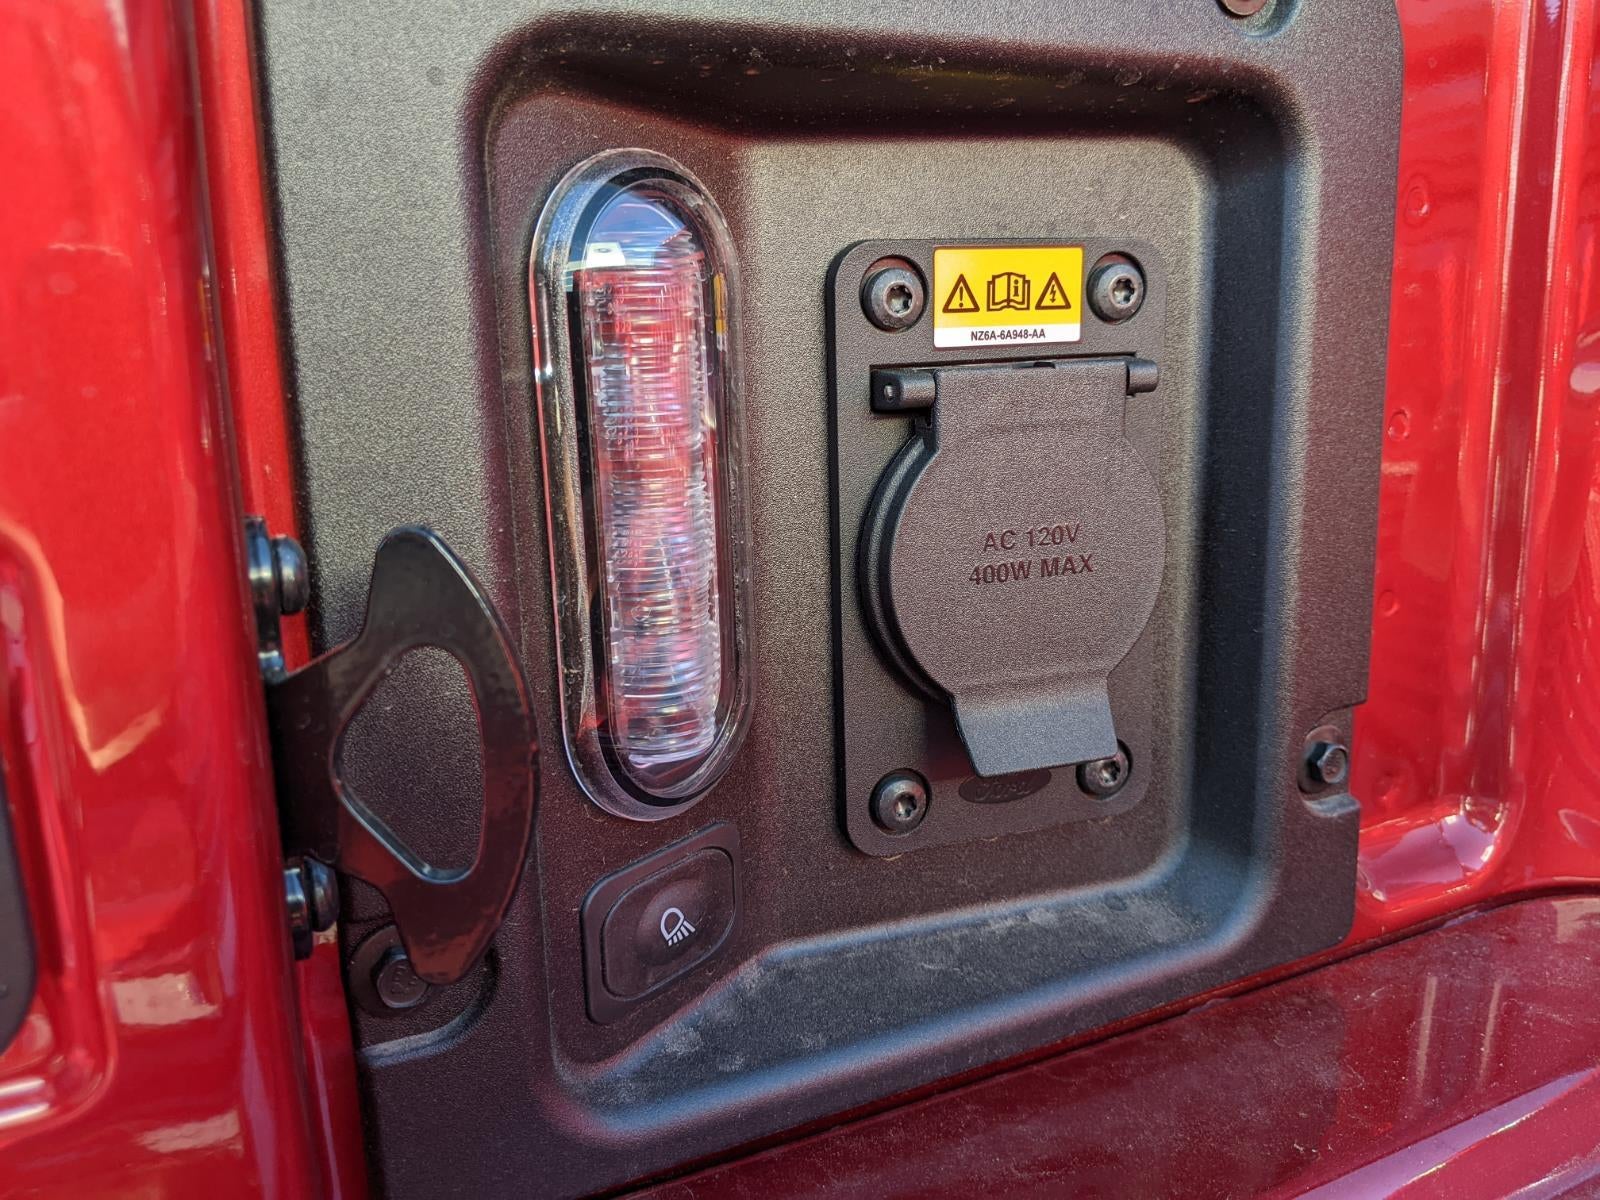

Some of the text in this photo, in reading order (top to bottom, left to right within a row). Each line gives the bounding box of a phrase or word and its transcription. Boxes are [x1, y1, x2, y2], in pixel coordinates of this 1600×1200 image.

[970, 328, 1046, 342] NZ6A-6A948-AA
[983, 522, 1080, 551] AC 120V
[969, 553, 1094, 585] 400W MAX
